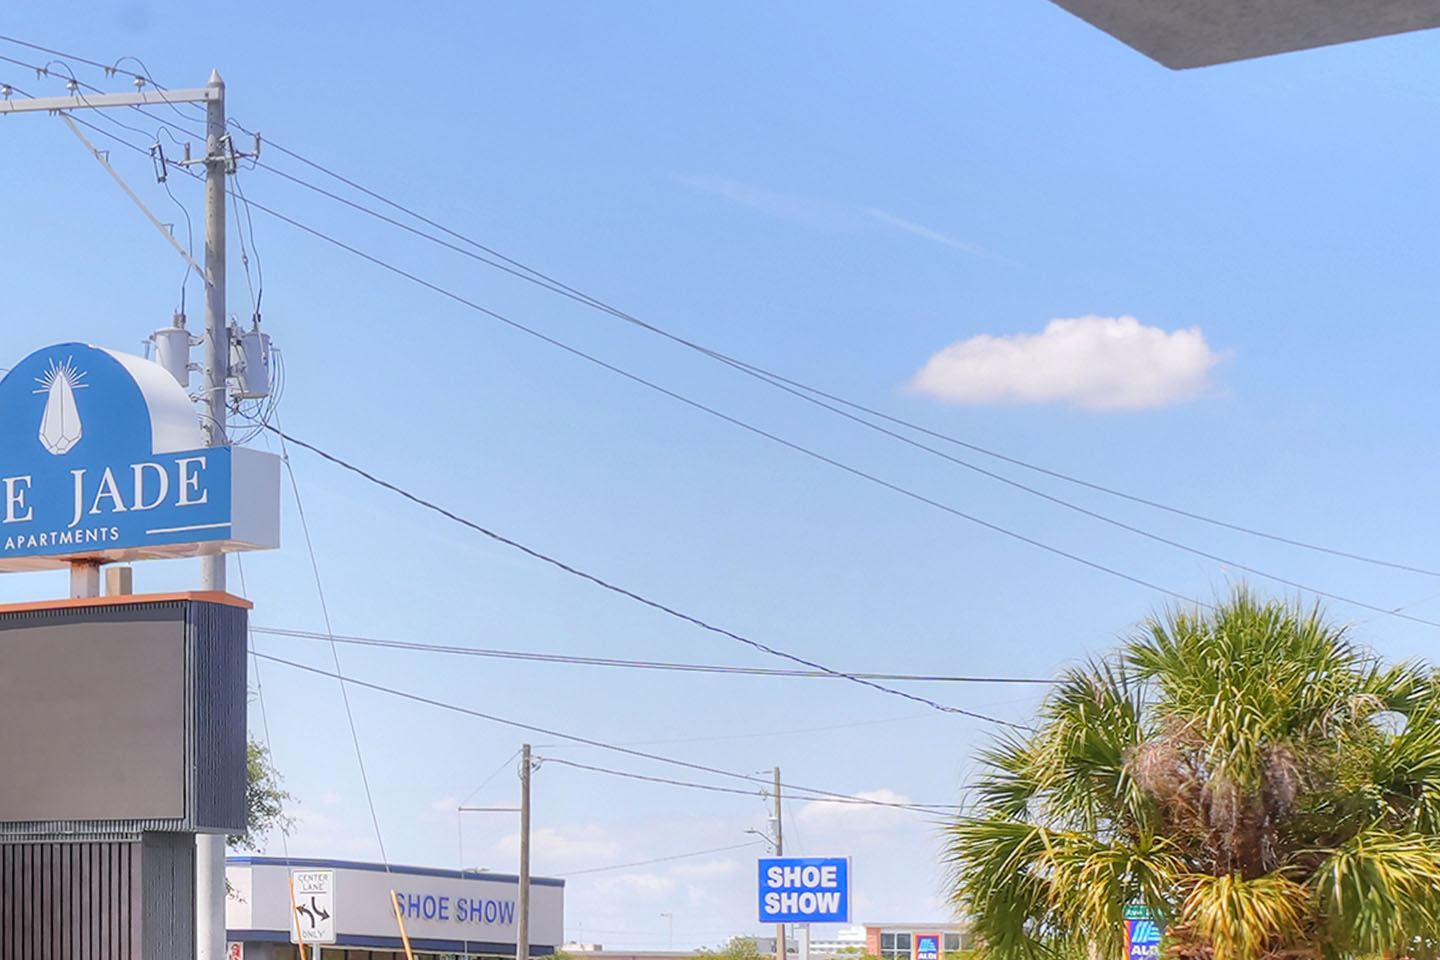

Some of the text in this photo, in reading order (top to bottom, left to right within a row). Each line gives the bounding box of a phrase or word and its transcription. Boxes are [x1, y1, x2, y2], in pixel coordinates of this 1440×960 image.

[68, 456, 208, 528] JADE
[4, 526, 120, 551] APARTMENTS
[298, 873, 329, 882] CENTER
[303, 882, 324, 891] LANE
[766, 866, 838, 888] SHOE
[393, 892, 515, 924] SHOE SHOW
[764, 892, 841, 914] SHOW
[302, 929, 326, 938] ONLY
[1131, 945, 1160, 956] ALD
